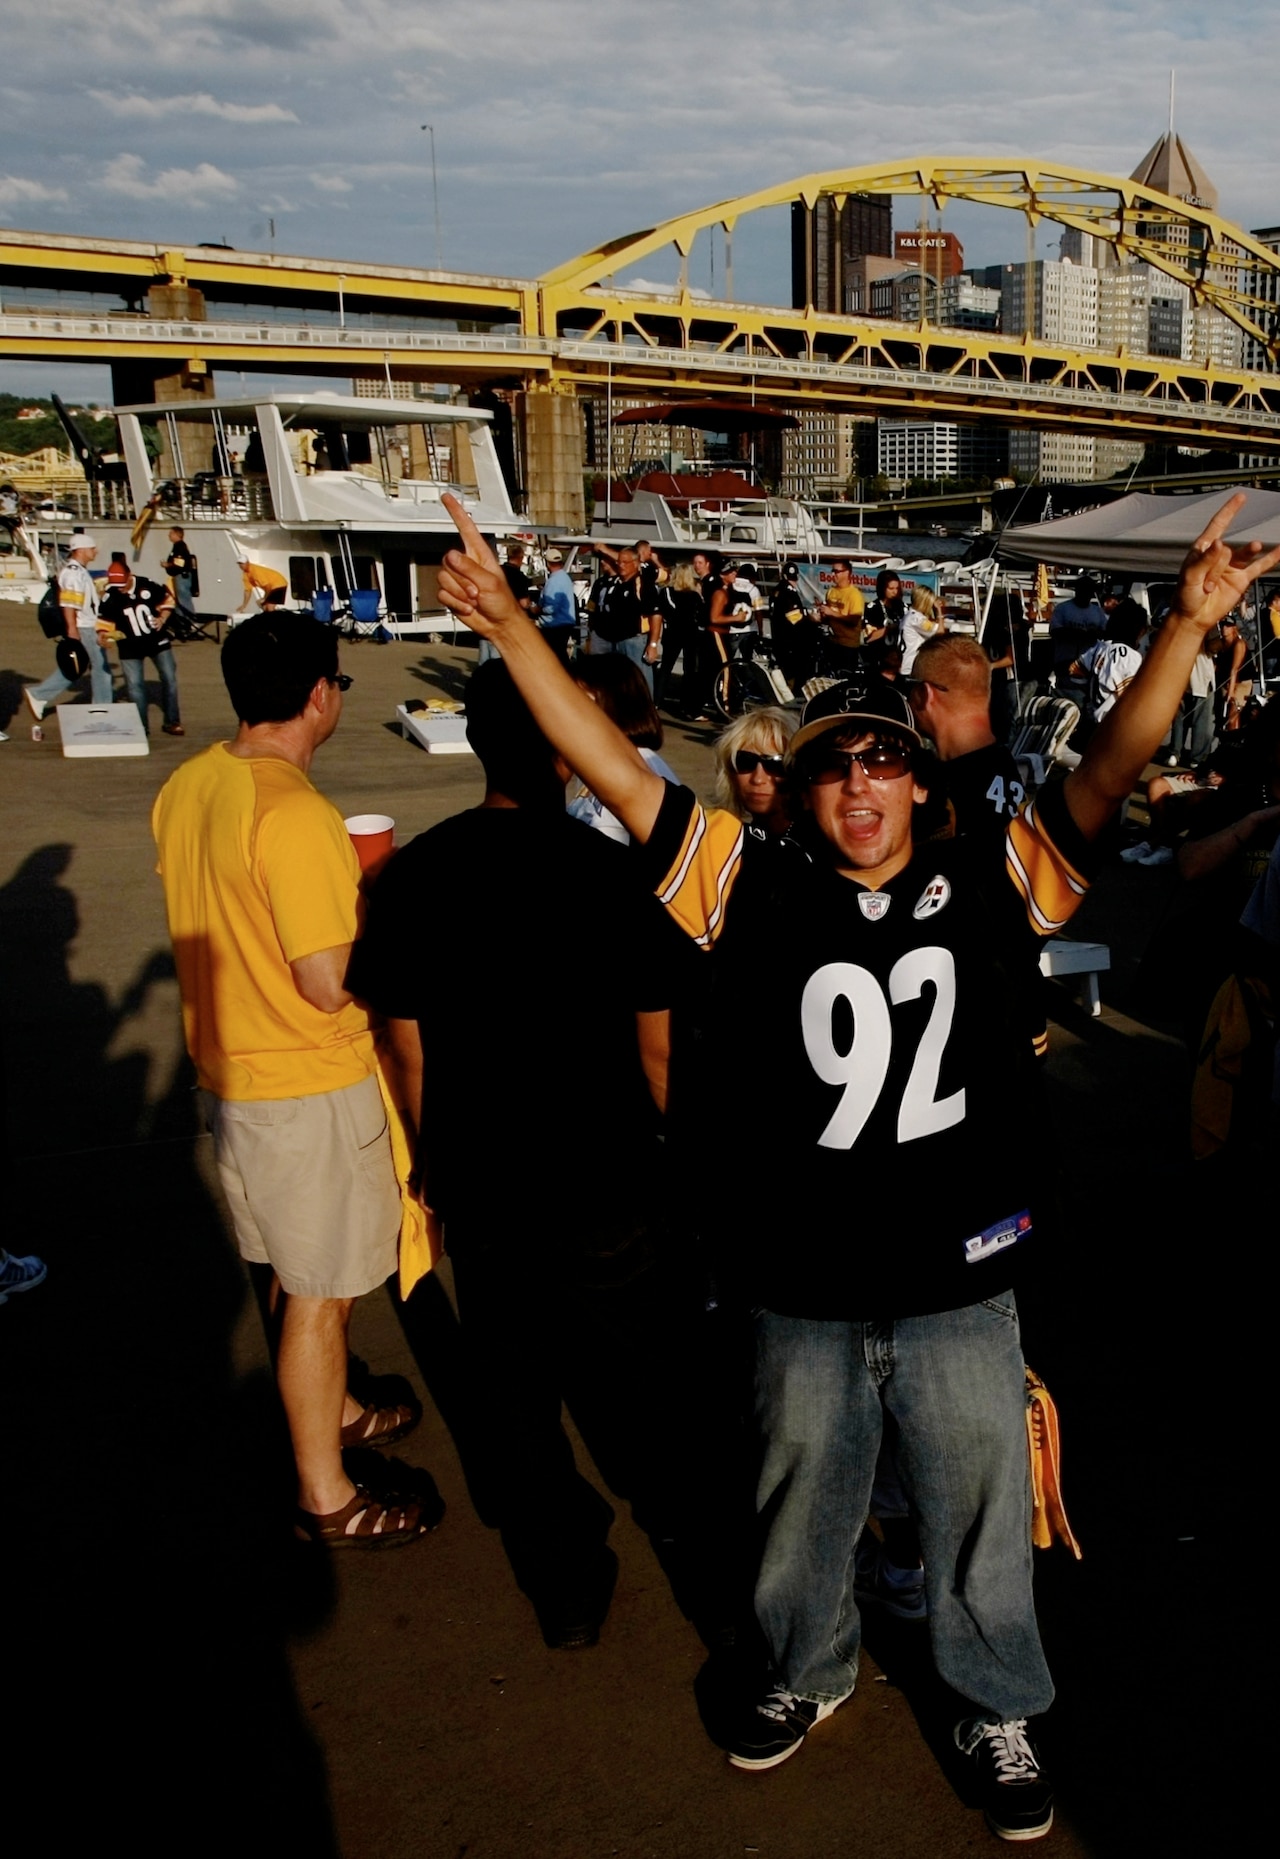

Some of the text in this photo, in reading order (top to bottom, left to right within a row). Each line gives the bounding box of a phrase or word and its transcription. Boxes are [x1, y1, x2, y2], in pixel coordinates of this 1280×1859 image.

[900, 238, 947, 248] K&L GATES
[123, 603, 151, 637] 10
[1110, 646, 1127, 664] 70
[985, 774, 1025, 819] 43
[800, 945, 968, 1152] 92
